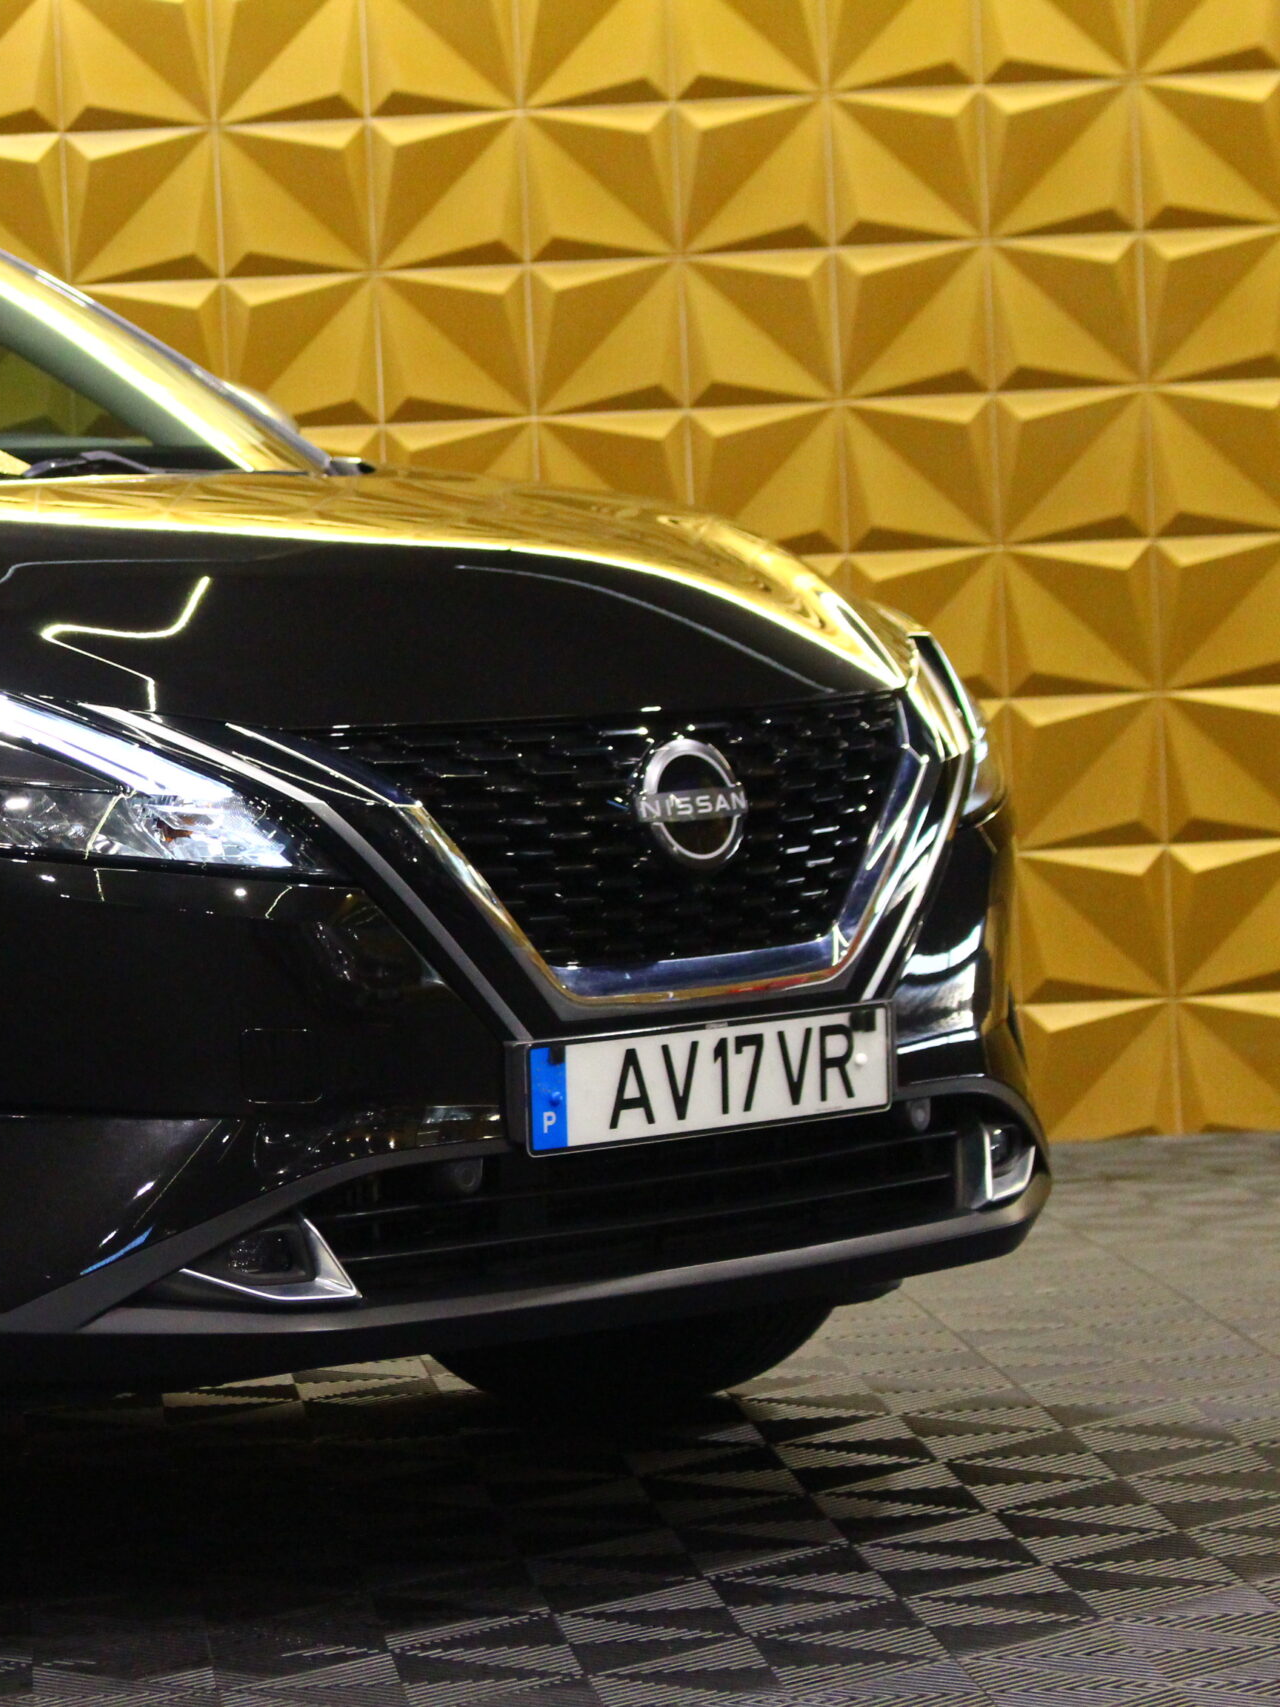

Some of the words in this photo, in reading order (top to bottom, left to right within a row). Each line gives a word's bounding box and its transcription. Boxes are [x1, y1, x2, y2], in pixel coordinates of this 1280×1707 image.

[640, 791, 747, 818] NISSAN
[609, 1041, 699, 1130] AV
[713, 1033, 764, 1115] 17
[777, 1023, 855, 1106] VR
[543, 1111, 556, 1134] P
